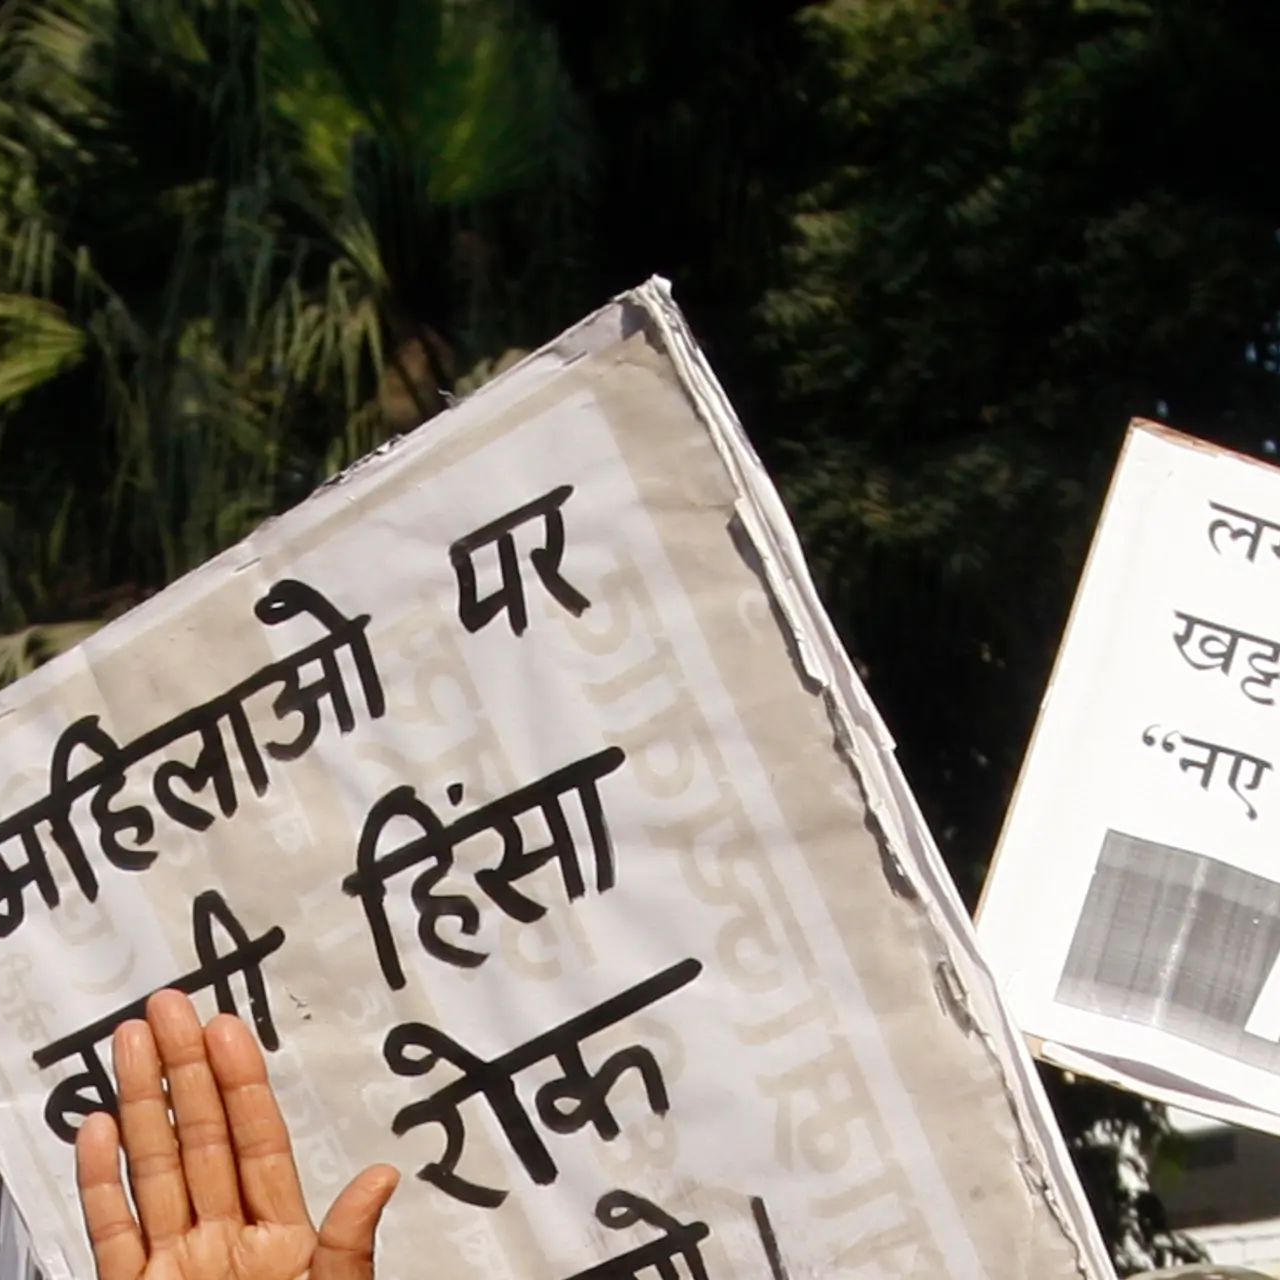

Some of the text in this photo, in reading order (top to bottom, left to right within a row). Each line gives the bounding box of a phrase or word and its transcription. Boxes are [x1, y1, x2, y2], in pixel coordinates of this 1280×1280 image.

[450, 486, 590, 636] पर
[342, 746, 626, 991] हिंसा
[384, 958, 702, 1210] रोक
